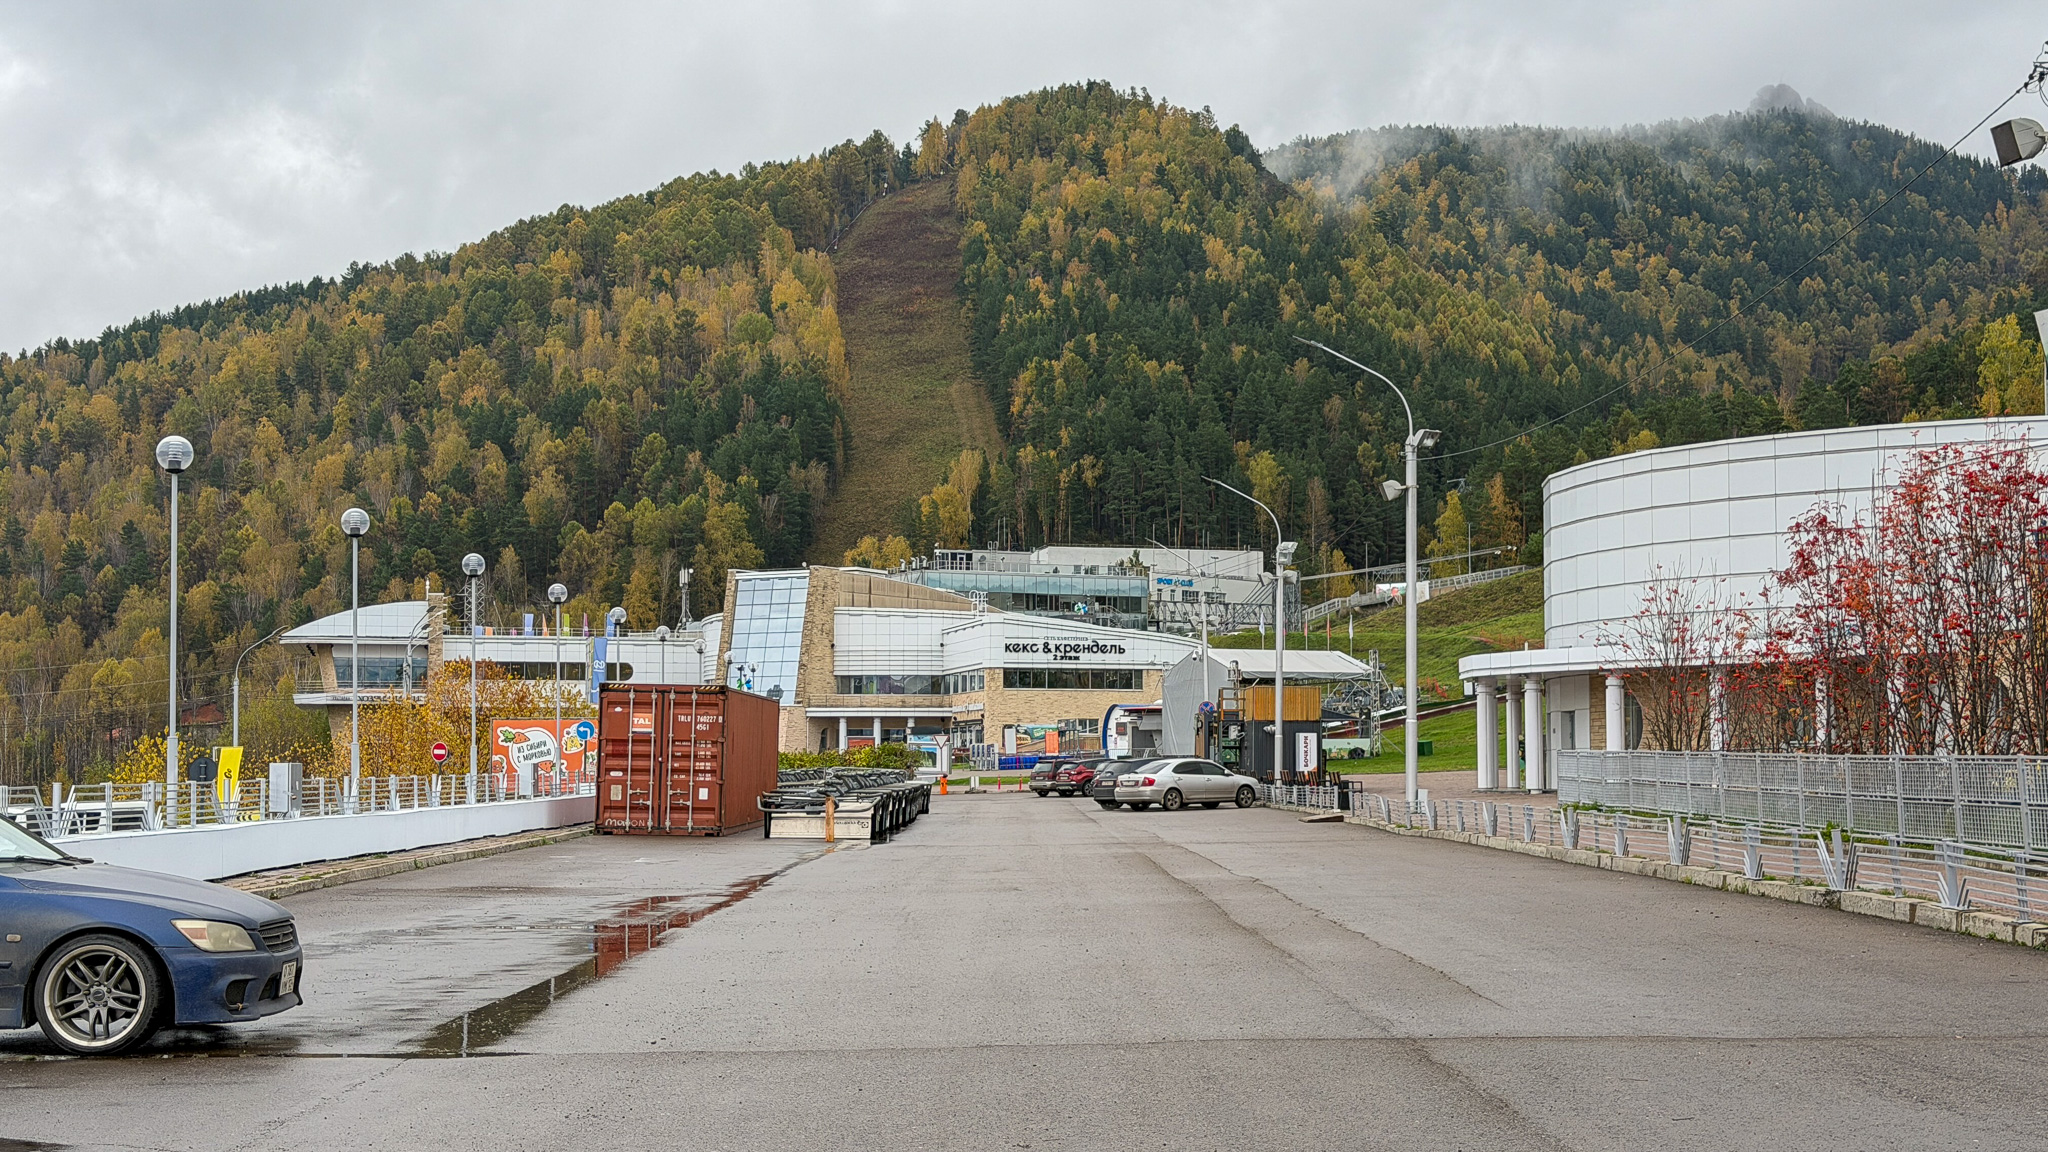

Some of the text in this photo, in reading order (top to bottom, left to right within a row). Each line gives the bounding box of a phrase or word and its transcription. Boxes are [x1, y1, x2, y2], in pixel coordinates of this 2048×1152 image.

[1004, 640, 1126, 655] кекс & крендель
[633, 717, 652, 725] TAL
[517, 740, 547, 754] ИЗ СИБИРИ
[522, 748, 552, 762] МОРКОВЬЮ
